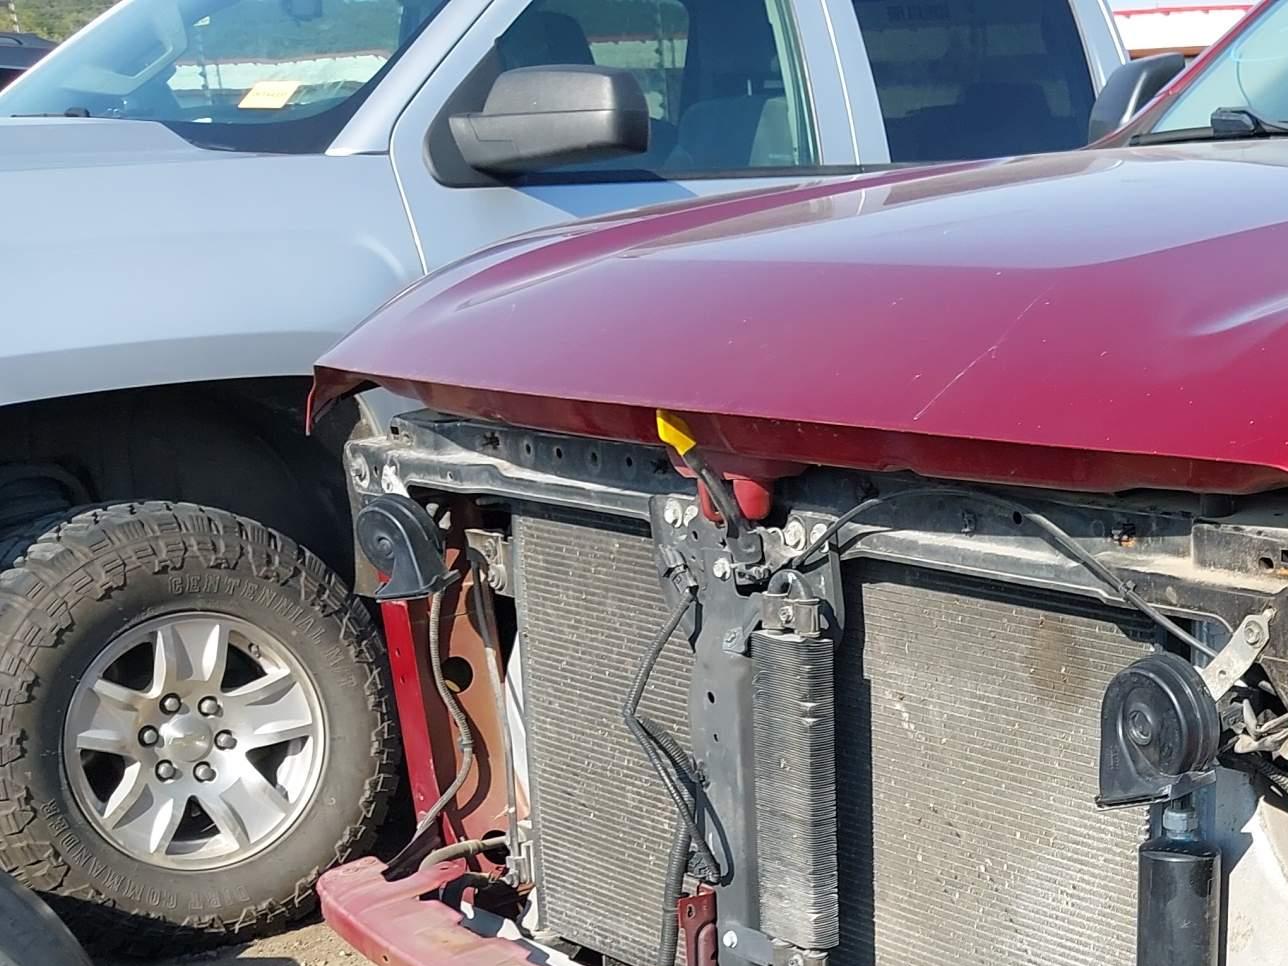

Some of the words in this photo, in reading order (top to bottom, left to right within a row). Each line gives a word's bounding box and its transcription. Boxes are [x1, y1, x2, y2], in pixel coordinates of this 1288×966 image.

[168, 574, 327, 645] CENTENNIAL
[40, 798, 178, 909] COMMANDER
[188, 885, 250, 911] DIRT
